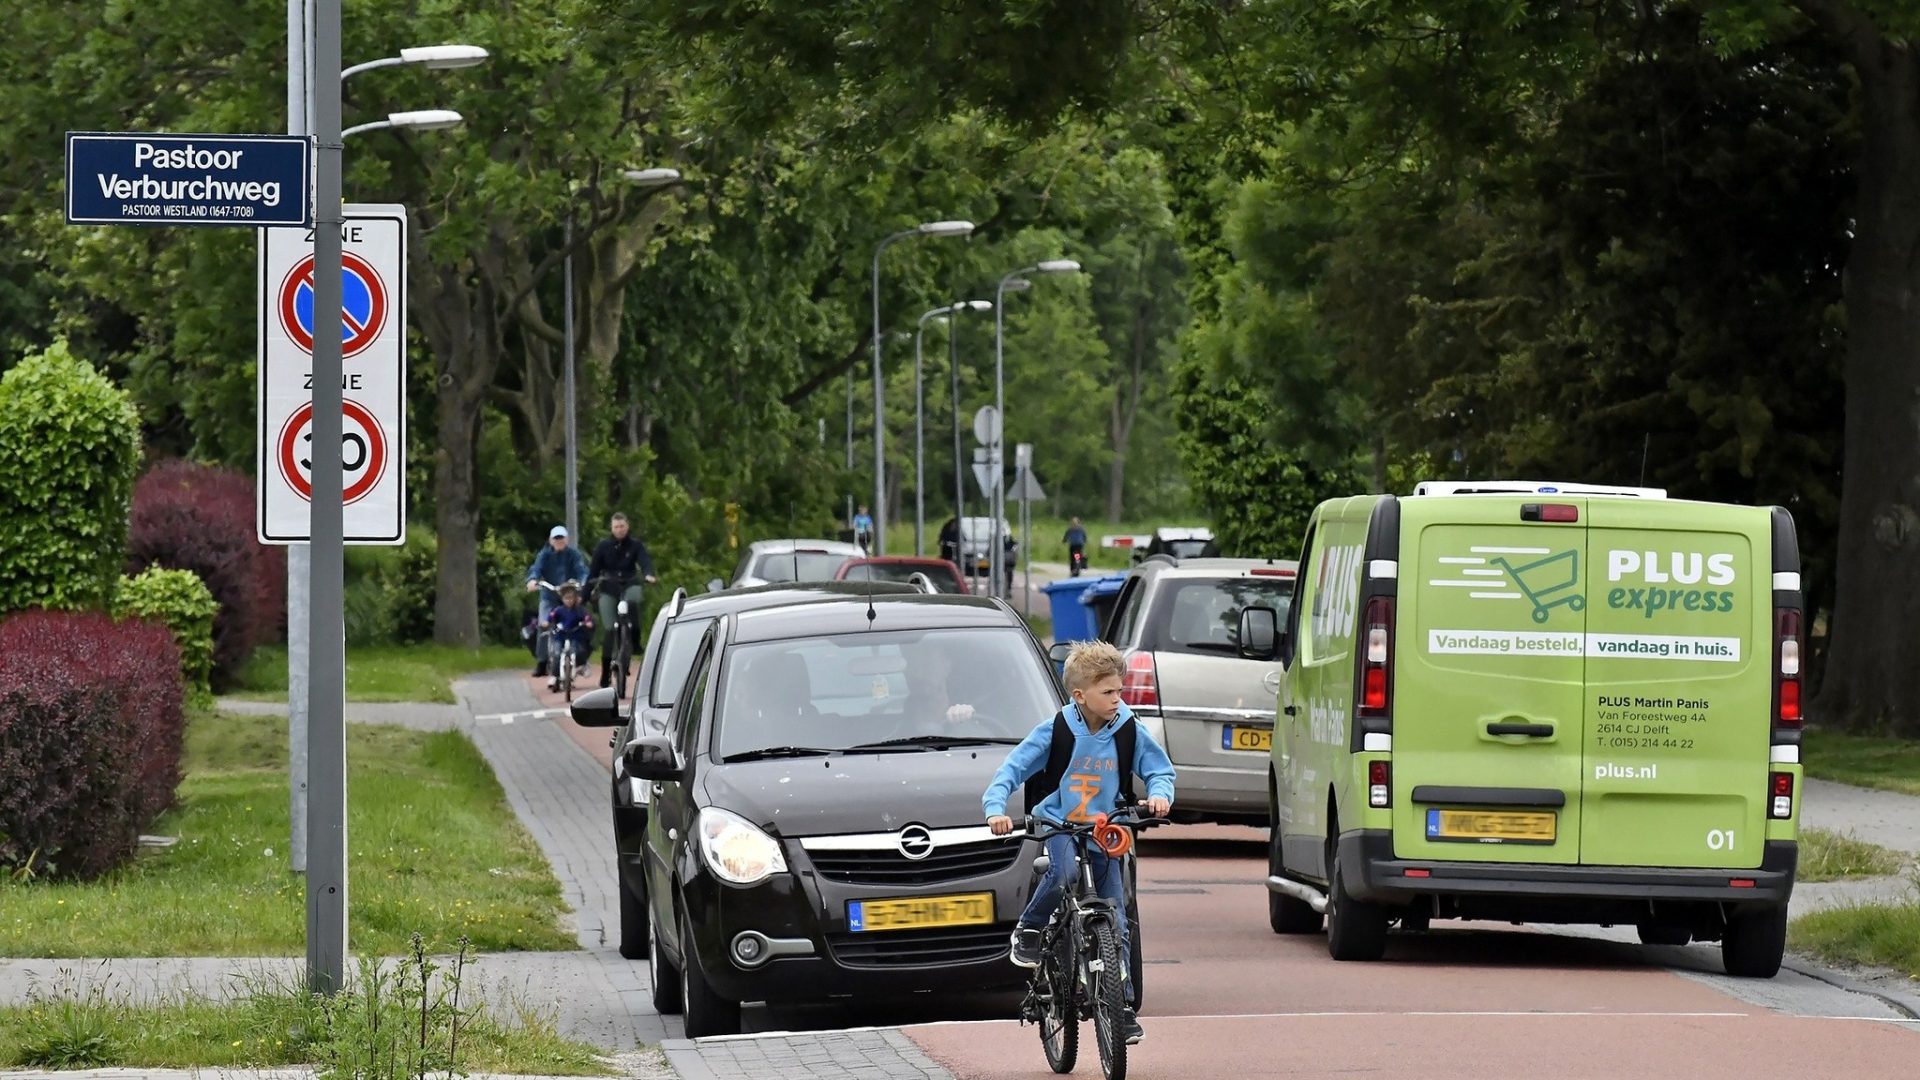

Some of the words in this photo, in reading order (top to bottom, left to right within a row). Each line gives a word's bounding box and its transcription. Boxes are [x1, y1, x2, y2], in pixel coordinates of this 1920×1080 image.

[135, 143, 243, 170] Pastoor
[97, 173, 281, 206] Verburchweg
[122, 204, 161, 216] PASTOOR
[163, 205, 208, 217] WESTLAND
[209, 206, 254, 218] (1647-1708)
[1608, 549, 1736, 586] PLUS
[1607, 586, 1734, 619] express
[1436, 635, 1510, 652] Vandaag
[1515, 636, 1583, 654] besteld,
[1597, 640, 1670, 656] vandaag
[1674, 641, 1690, 654] in
[1694, 642, 1733, 656] huis.
[1598, 696, 1631, 707] PLUS
[1634, 697, 1673, 708] Martin
[1676, 698, 1709, 709] Panis
[1597, 711, 1619, 720] Van
[1622, 711, 1687, 723] Foreestweg
[1690, 713, 1707, 722] 4A
[1597, 724, 1622, 733] 2614
[1625, 725, 1640, 734] CJ
[1643, 725, 1670, 735] Delft
[1597, 737, 1607, 746] T.
[1610, 738, 1638, 748] (015)
[1641, 739, 1659, 747] 214
[1662, 739, 1677, 748] 44
[1680, 740, 1694, 749] 22
[1595, 762, 1657, 780] plus.nl
[1706, 829, 1734, 850] 01
[850, 919, 861, 927] NL
